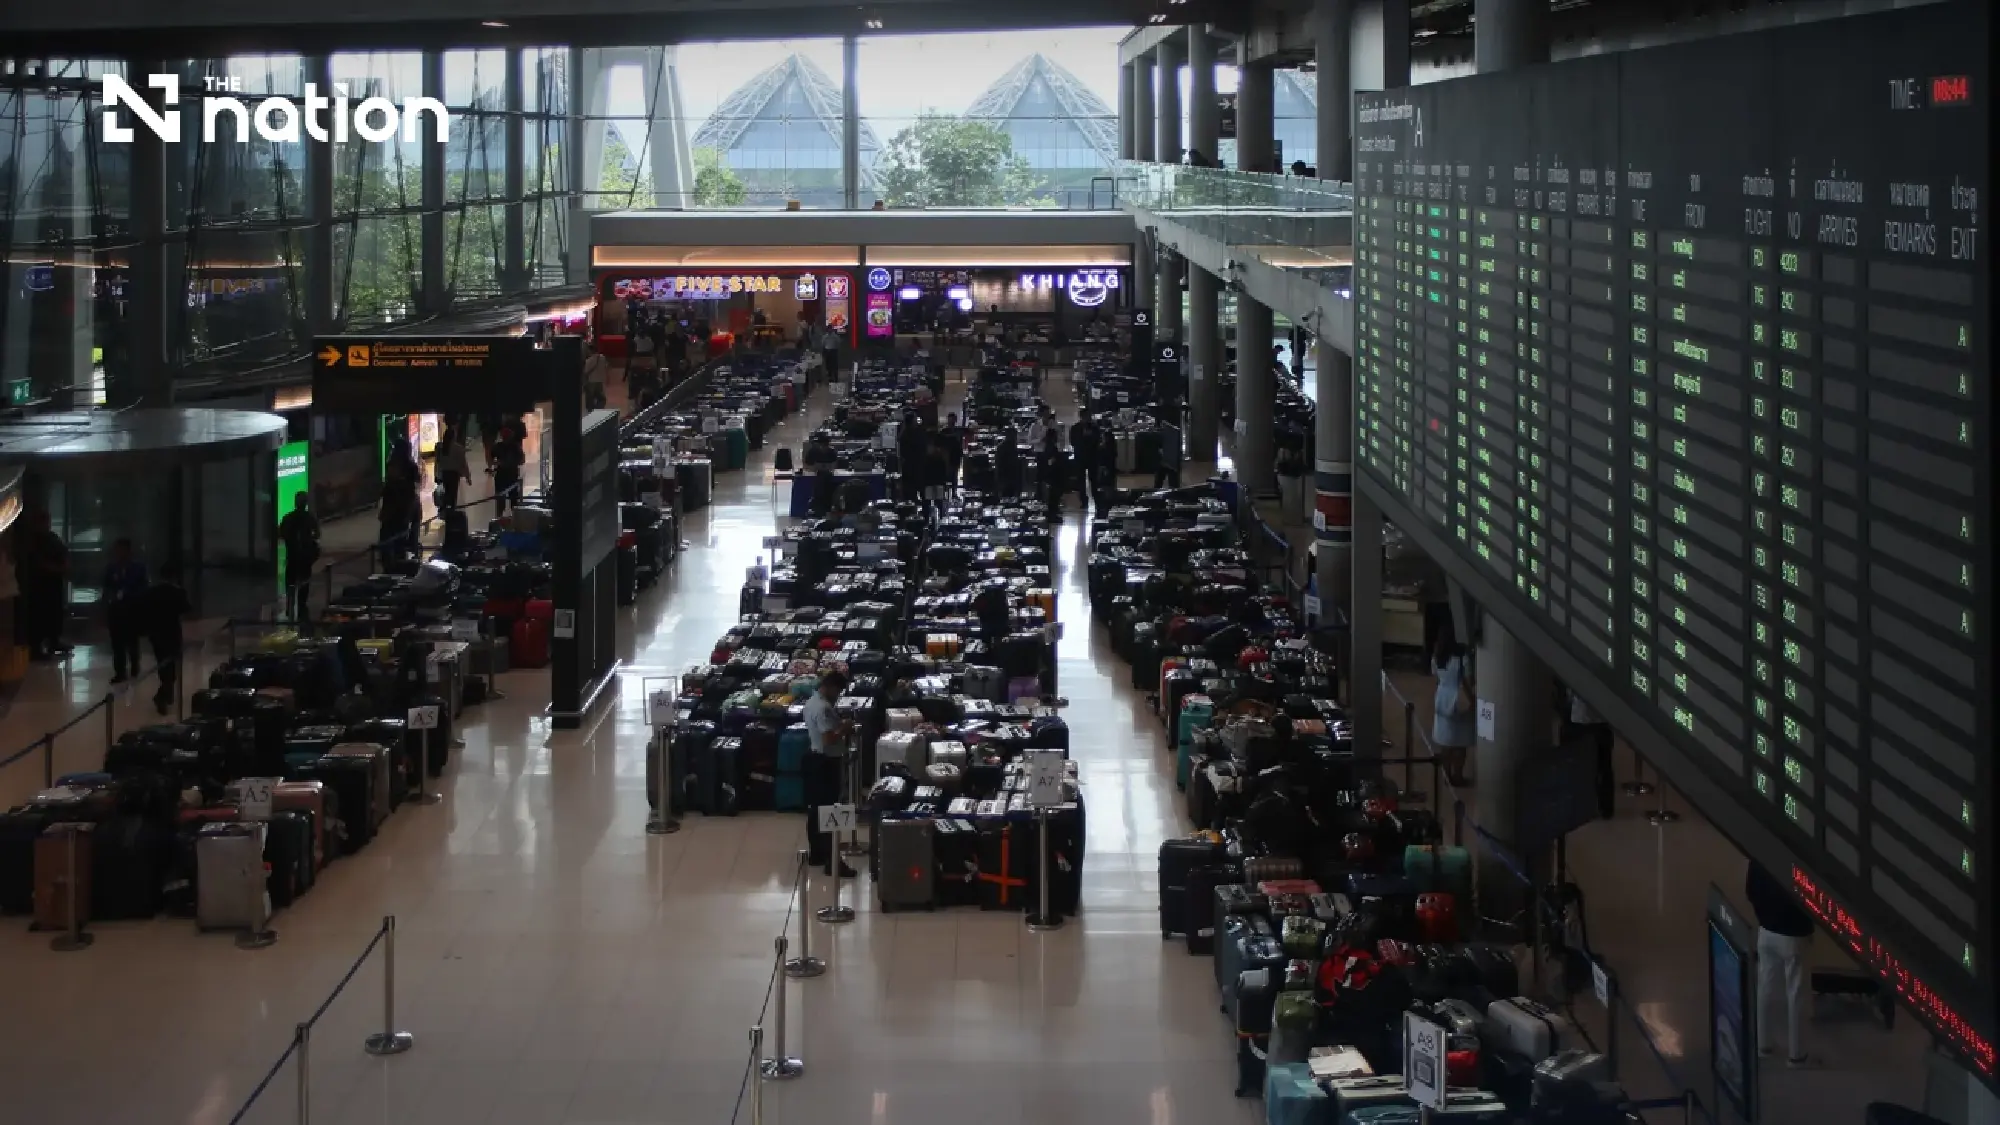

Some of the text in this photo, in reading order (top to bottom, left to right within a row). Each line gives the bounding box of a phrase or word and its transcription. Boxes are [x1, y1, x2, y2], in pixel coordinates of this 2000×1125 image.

[1934, 78, 1968, 102] 08:44
[1884, 220, 1937, 256] REMARKS
[1951, 227, 1979, 260] EXIT
[676, 276, 723, 292] FIVE
[730, 276, 781, 292] STAR
[1022, 274, 1119, 289] KHIANG
[1038, 776, 1054, 787] A7
[244, 785, 269, 803] A5
[825, 810, 850, 828] A7
[1417, 1031, 1435, 1051] A8
